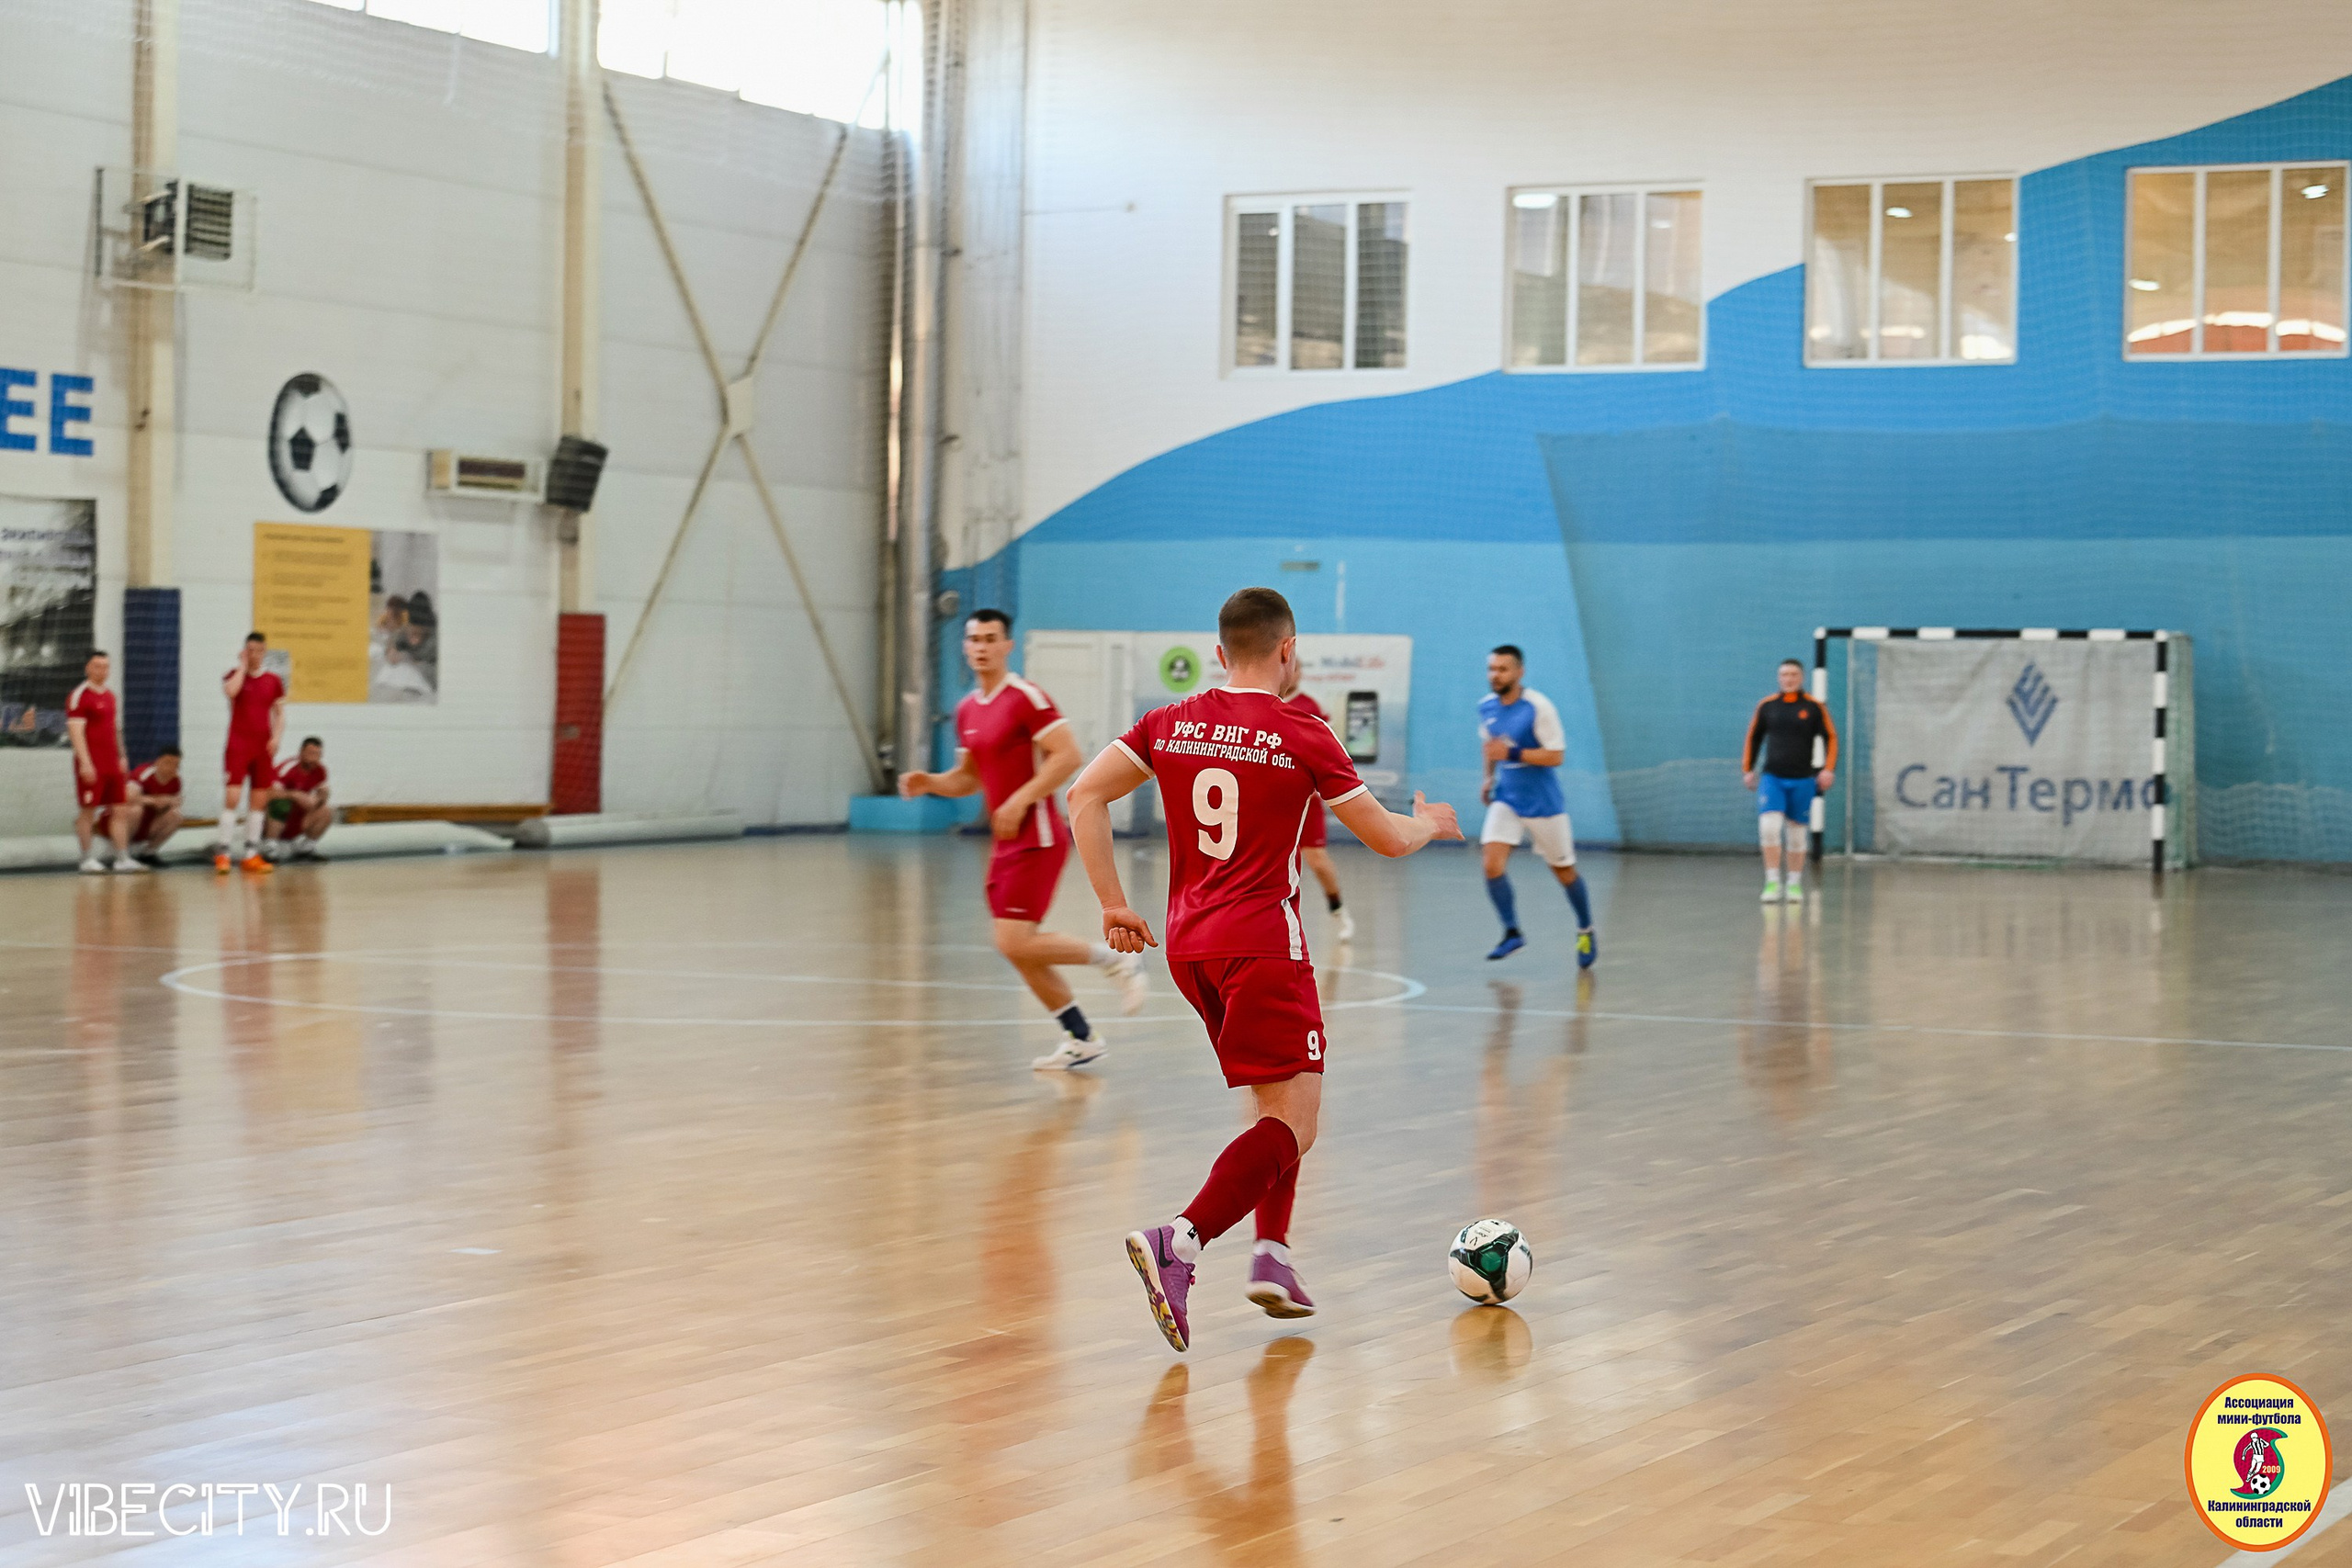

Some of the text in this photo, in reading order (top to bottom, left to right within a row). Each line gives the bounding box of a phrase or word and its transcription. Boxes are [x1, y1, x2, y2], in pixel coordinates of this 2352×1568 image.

[1171, 720, 1282, 750] УФС ВНГ РФ
[1165, 739, 1268, 764] КАЛИНИНГРАДСКОЙ
[1272, 752, 1295, 770] обл.
[1193, 767, 1238, 861] 9
[1307, 1030, 1322, 1061] 9
